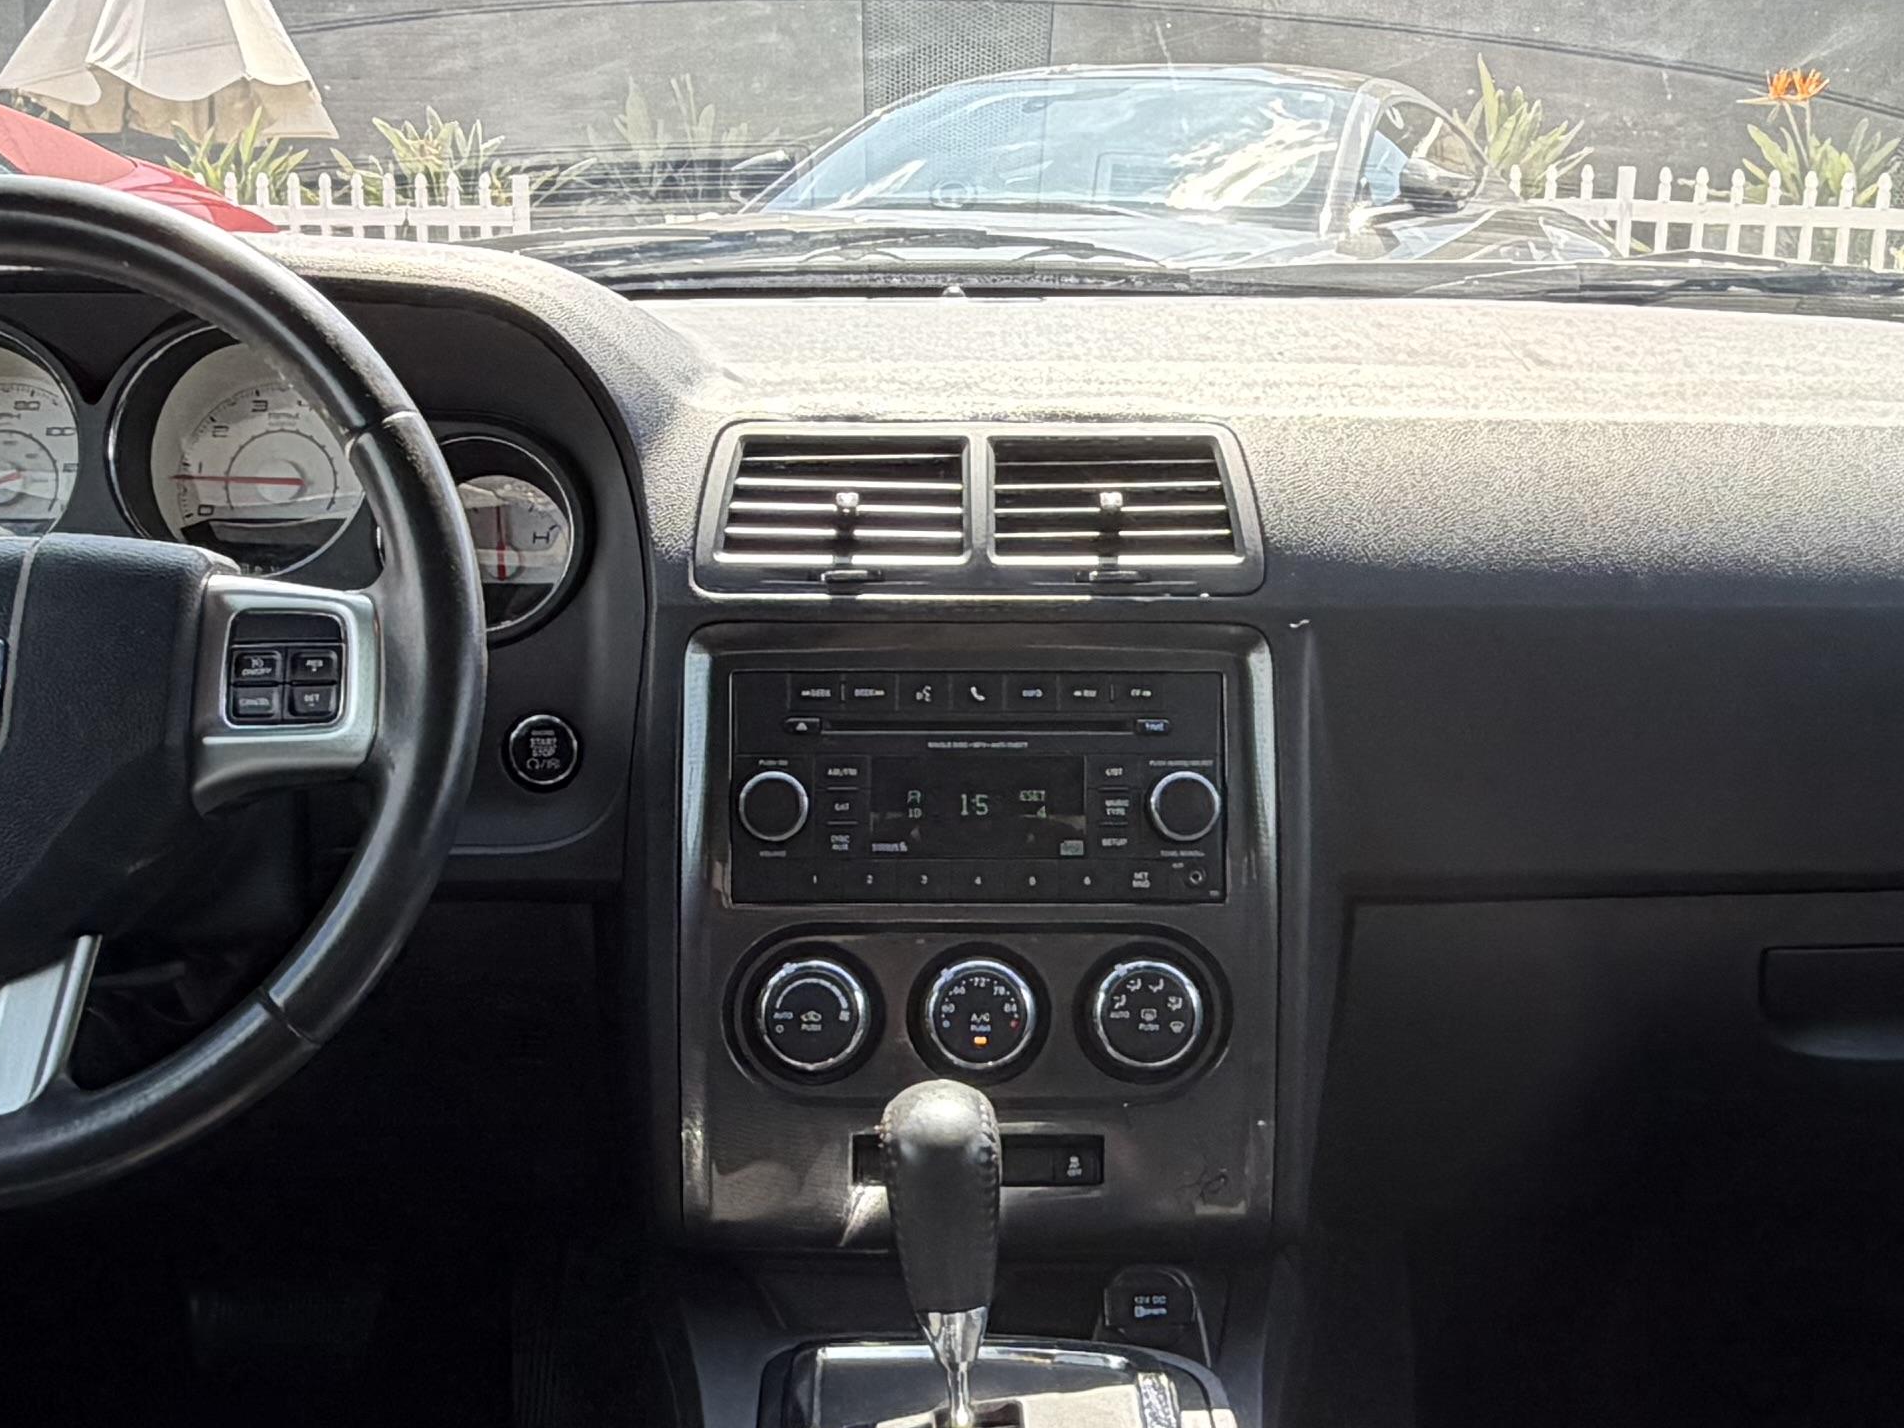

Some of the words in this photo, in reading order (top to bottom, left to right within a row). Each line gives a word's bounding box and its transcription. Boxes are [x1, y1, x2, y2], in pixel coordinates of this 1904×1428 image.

[251, 400, 268, 412] 3
[197, 504, 215, 517] 0
[532, 532, 550, 544] H
[970, 1012, 990, 1024] A/C
